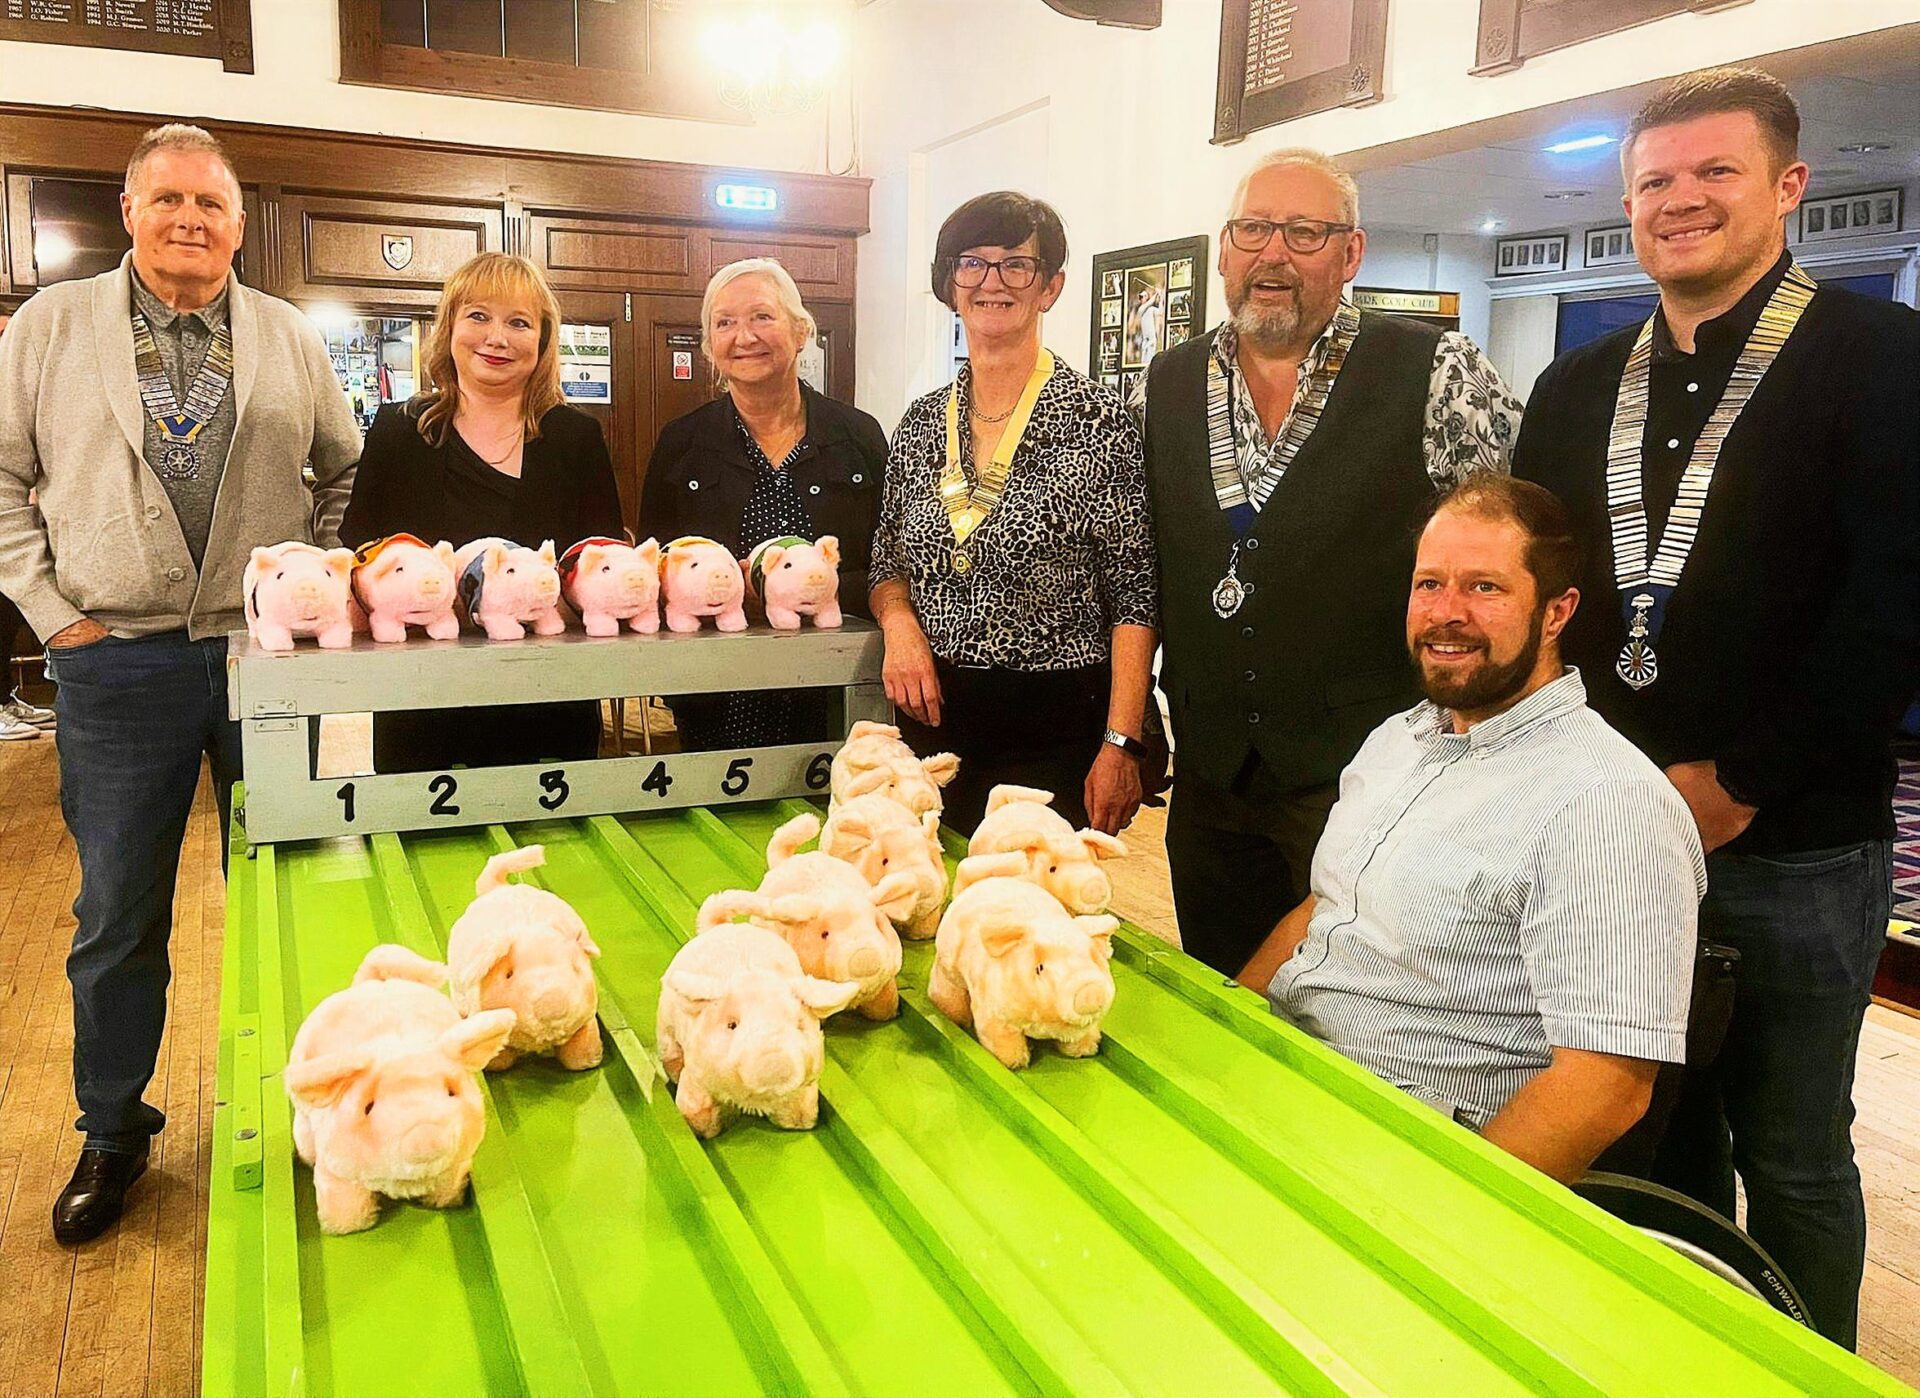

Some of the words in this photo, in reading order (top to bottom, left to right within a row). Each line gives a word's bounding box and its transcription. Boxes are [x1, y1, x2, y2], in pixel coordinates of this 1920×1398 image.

[337, 783, 355, 822] 1
[429, 775, 460, 815] 2
[539, 770, 569, 811] 3
[641, 761, 673, 797] 4
[721, 758, 753, 796] 5
[805, 753, 833, 789] 6
